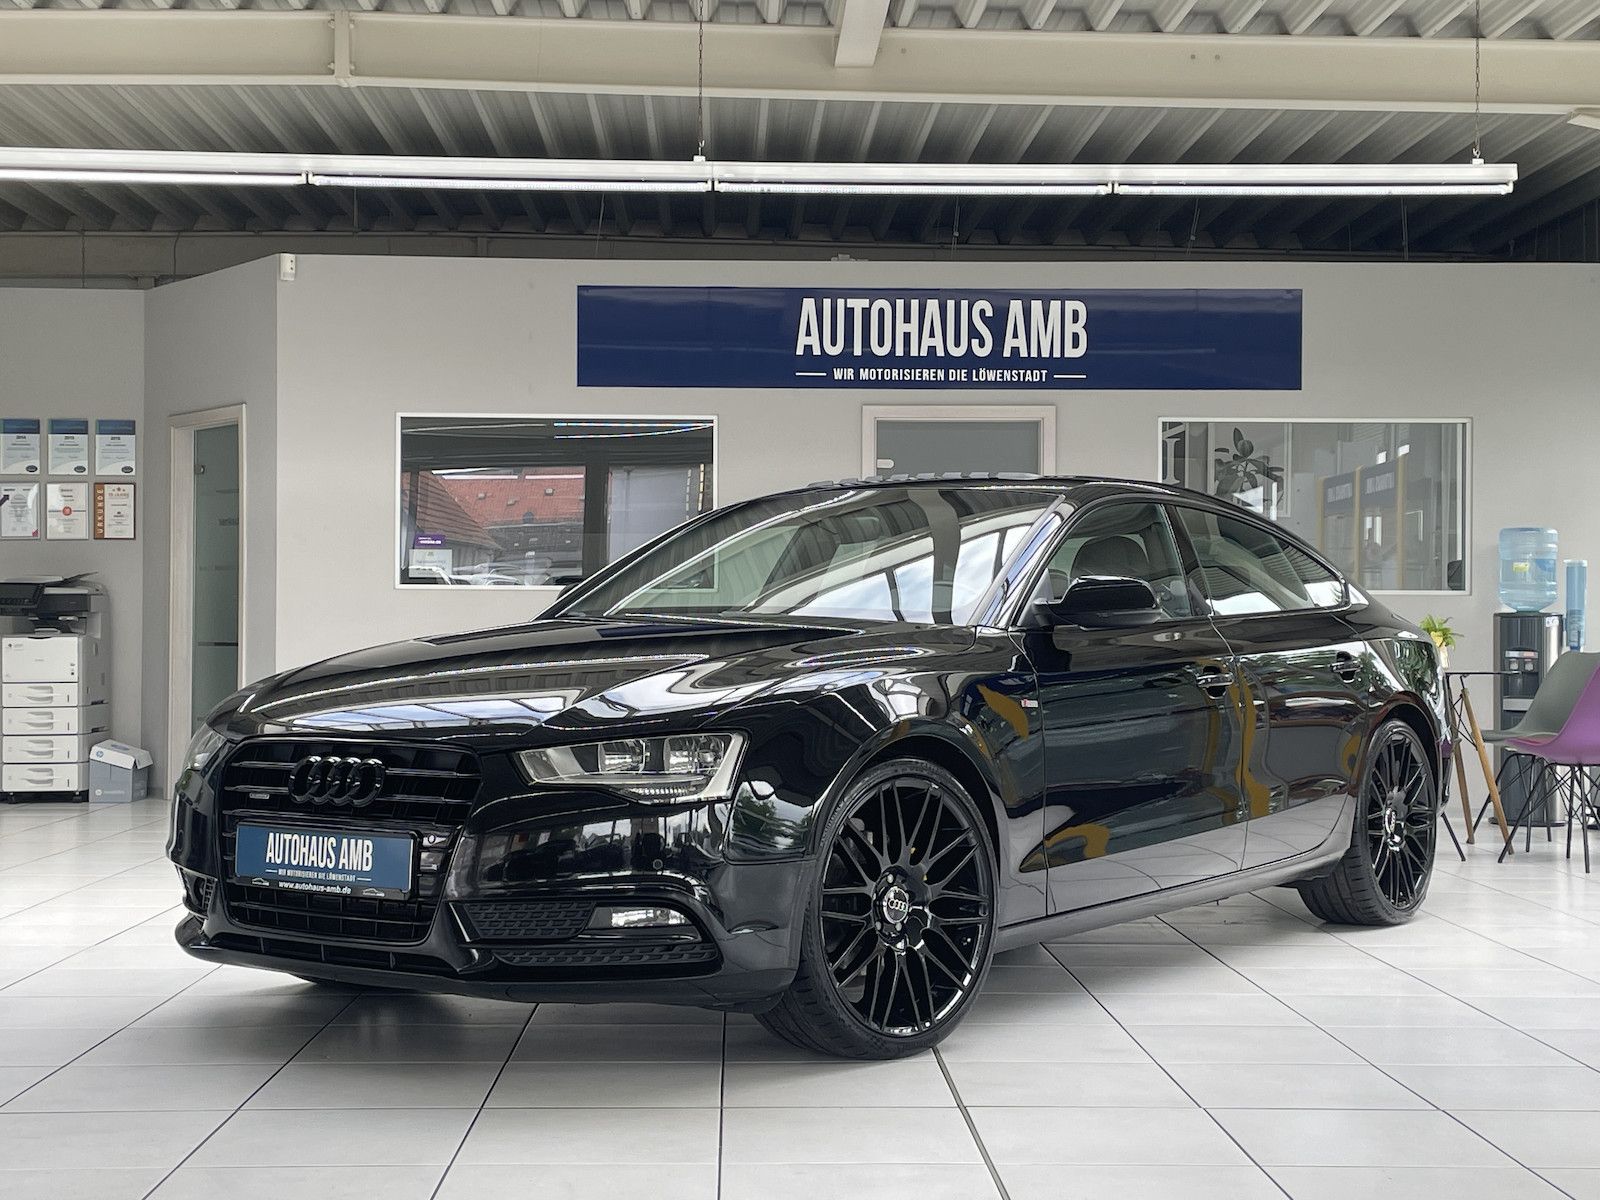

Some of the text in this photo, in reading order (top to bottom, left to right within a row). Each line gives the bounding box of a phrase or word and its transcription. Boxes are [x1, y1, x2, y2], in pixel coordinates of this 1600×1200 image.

[795, 297, 1088, 359] AUTOHAUS AMB
[833, 367, 1048, 382] WIR MOTORISIEREN DIE LÖWENSTADT
[96, 488, 104, 534] URKUNDE
[265, 832, 374, 872] AUTOHAUS AMB
[278, 880, 352, 895] www.autohaus-amb.de
